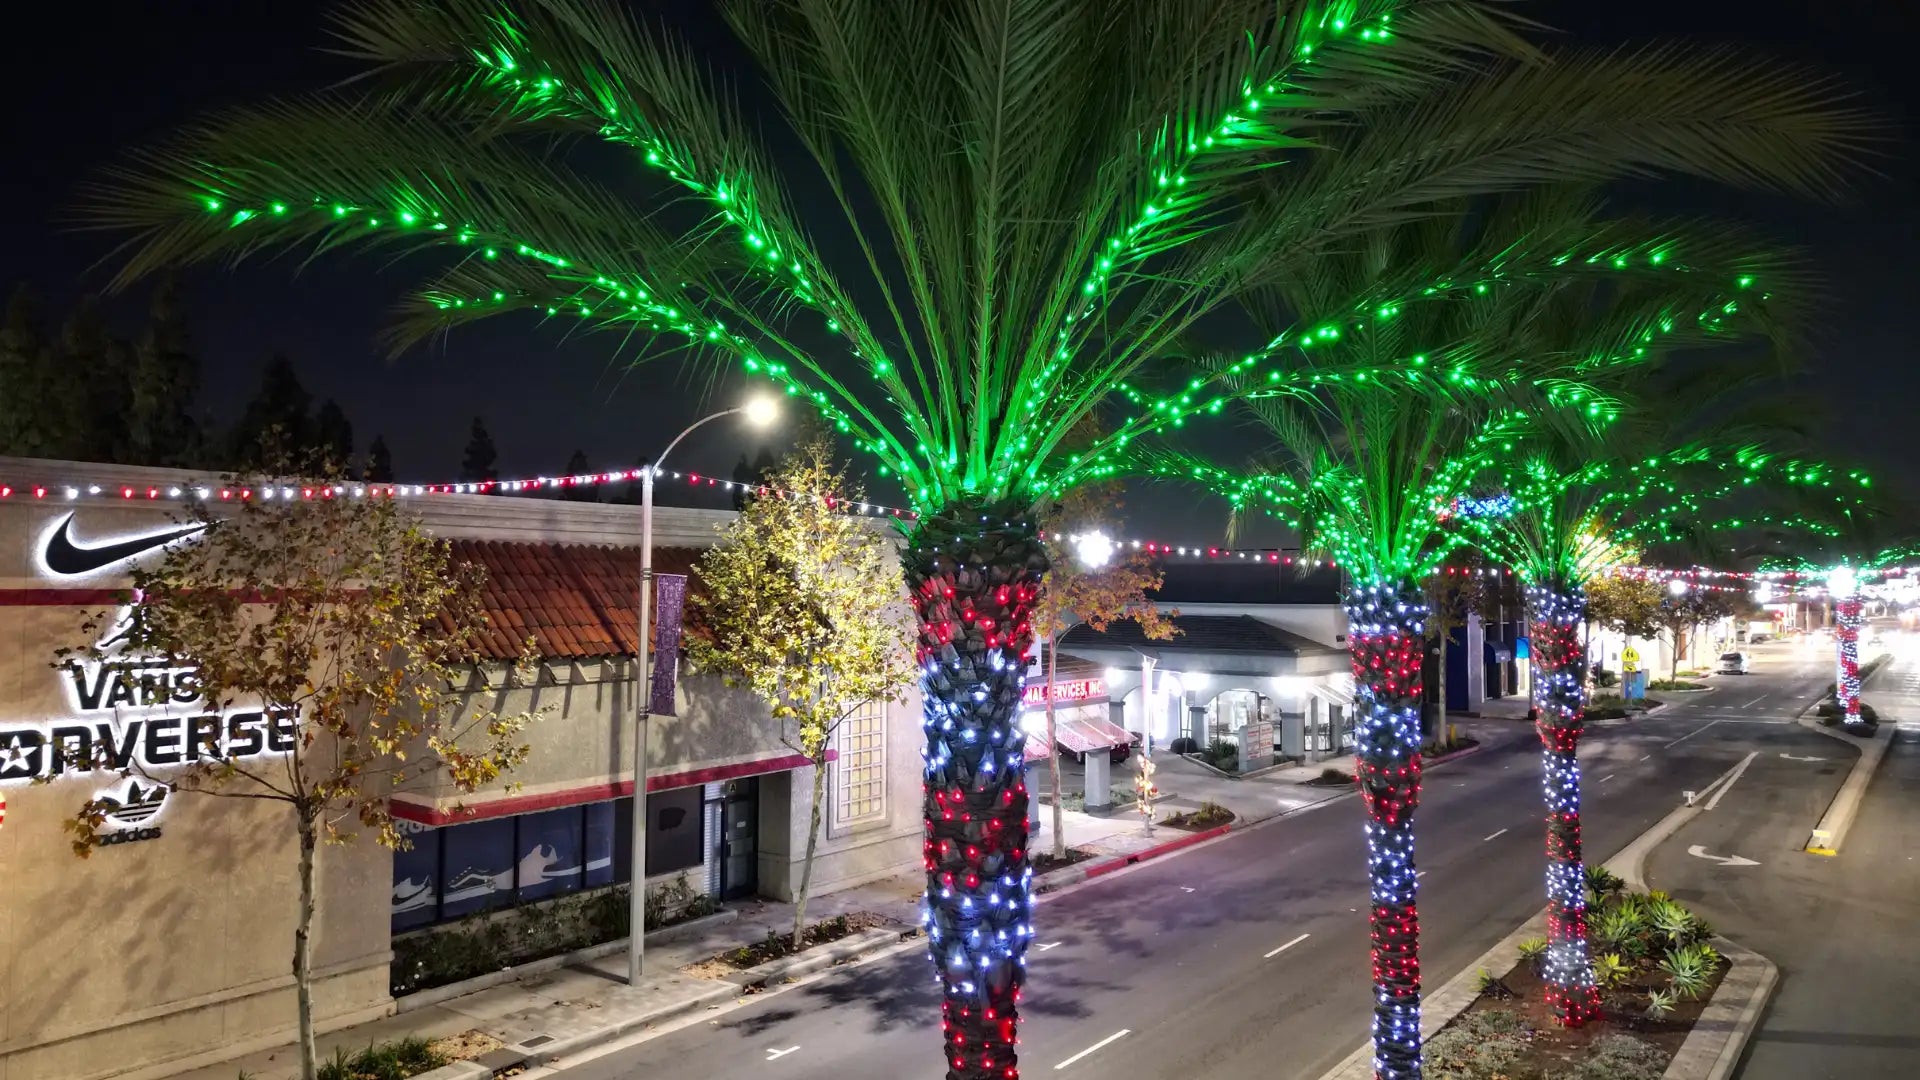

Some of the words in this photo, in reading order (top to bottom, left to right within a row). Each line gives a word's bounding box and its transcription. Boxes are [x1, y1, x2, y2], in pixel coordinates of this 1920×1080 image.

[70, 660, 202, 709] VANS
[1047, 681, 1088, 701] ERVICES,
[98, 827, 162, 846] adidas
